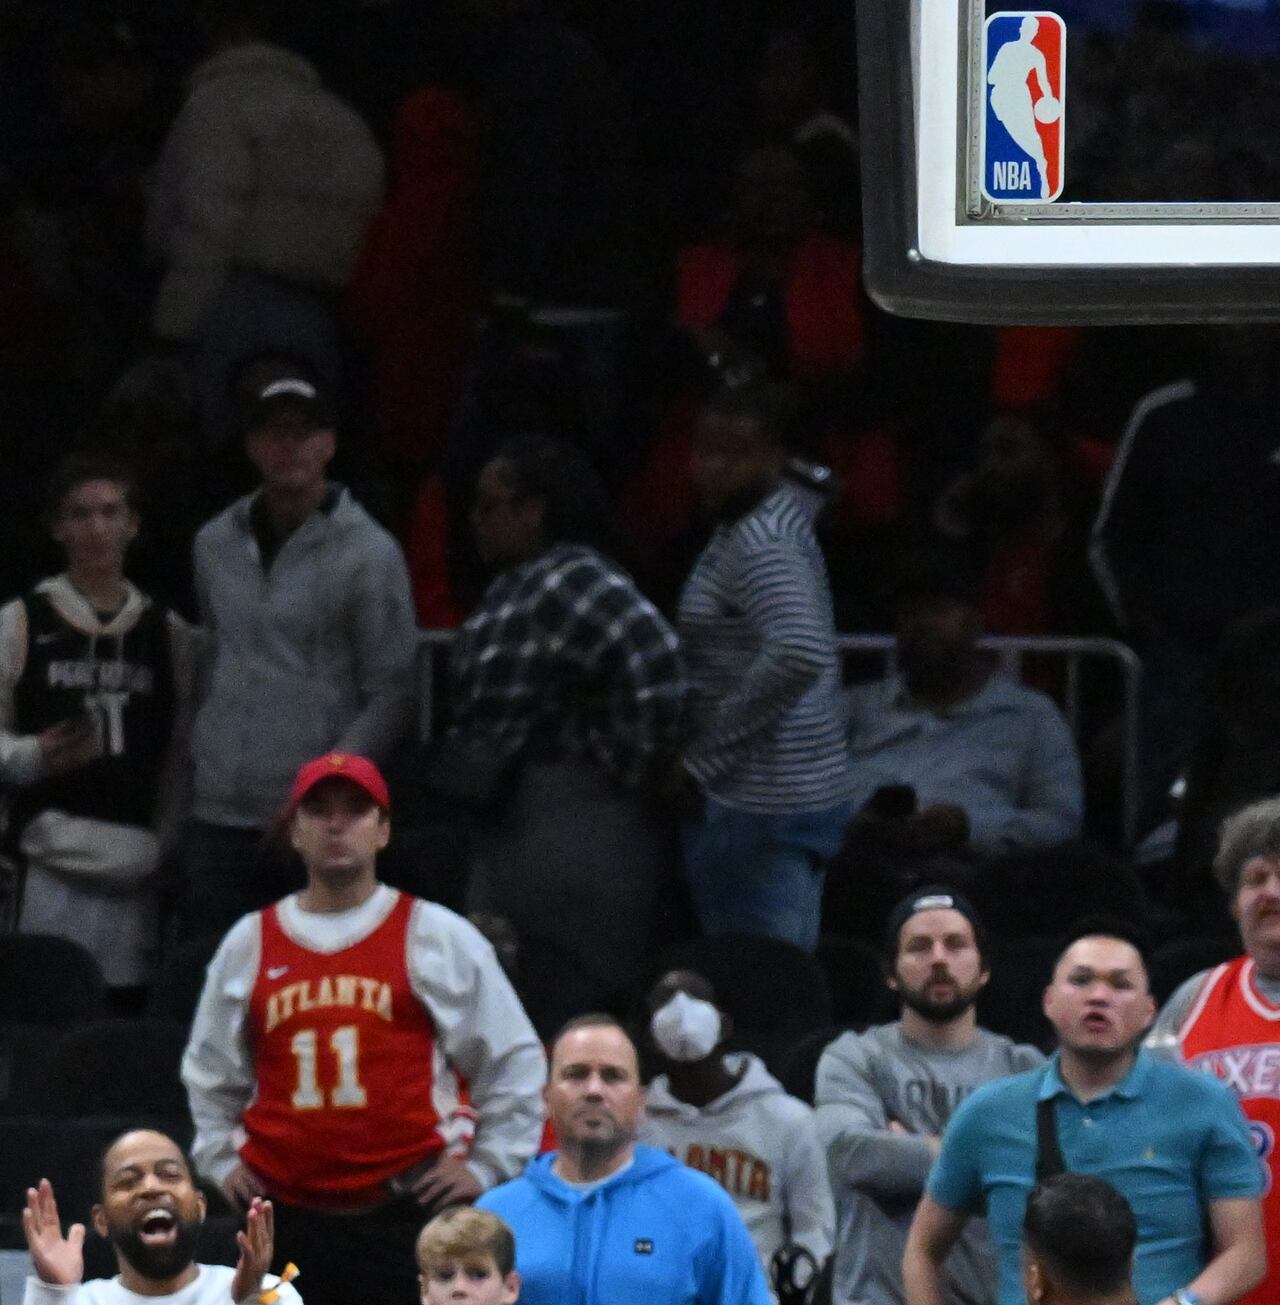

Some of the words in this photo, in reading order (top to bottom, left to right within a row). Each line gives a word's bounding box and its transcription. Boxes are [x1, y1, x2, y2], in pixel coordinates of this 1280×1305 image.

[993, 161, 1032, 191] NBA
[265, 974, 392, 1034] ATLANTA
[291, 1025, 367, 1109] 11
